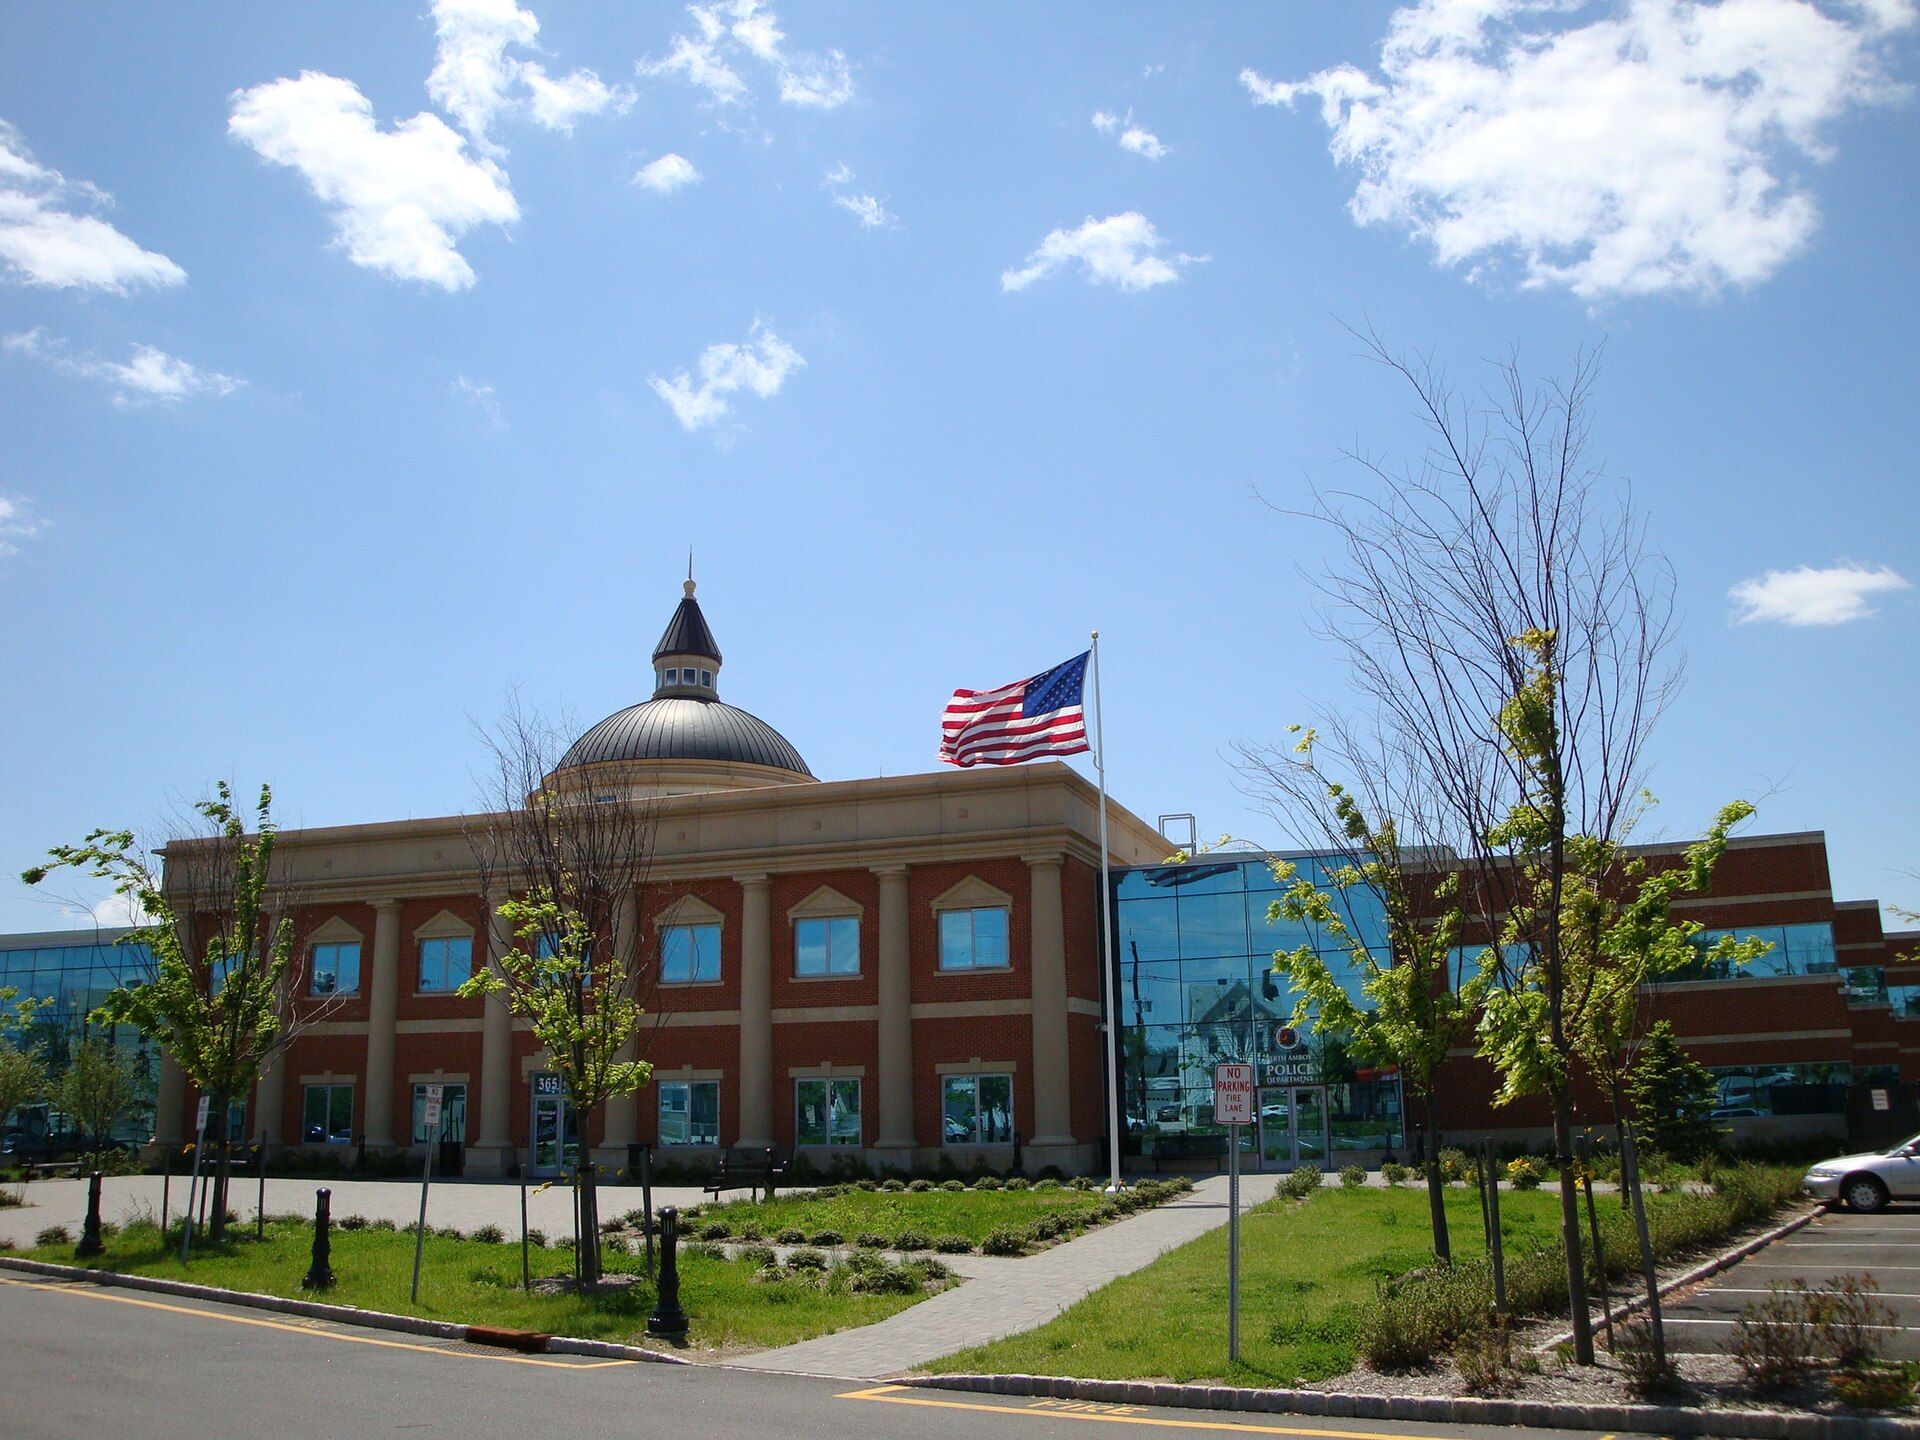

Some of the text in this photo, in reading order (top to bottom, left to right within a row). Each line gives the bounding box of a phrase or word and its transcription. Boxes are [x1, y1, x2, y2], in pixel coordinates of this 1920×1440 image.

[1227, 1068, 1241, 1078] NO
[1266, 1064, 1314, 1076] POLICE
[538, 1077, 558, 1091] 365
[1267, 1076, 1313, 1084] DEPARTMENT
[1218, 1081, 1250, 1092] PARKING
[1226, 1094, 1242, 1102] FIRE
[1225, 1104, 1243, 1112] LANE
